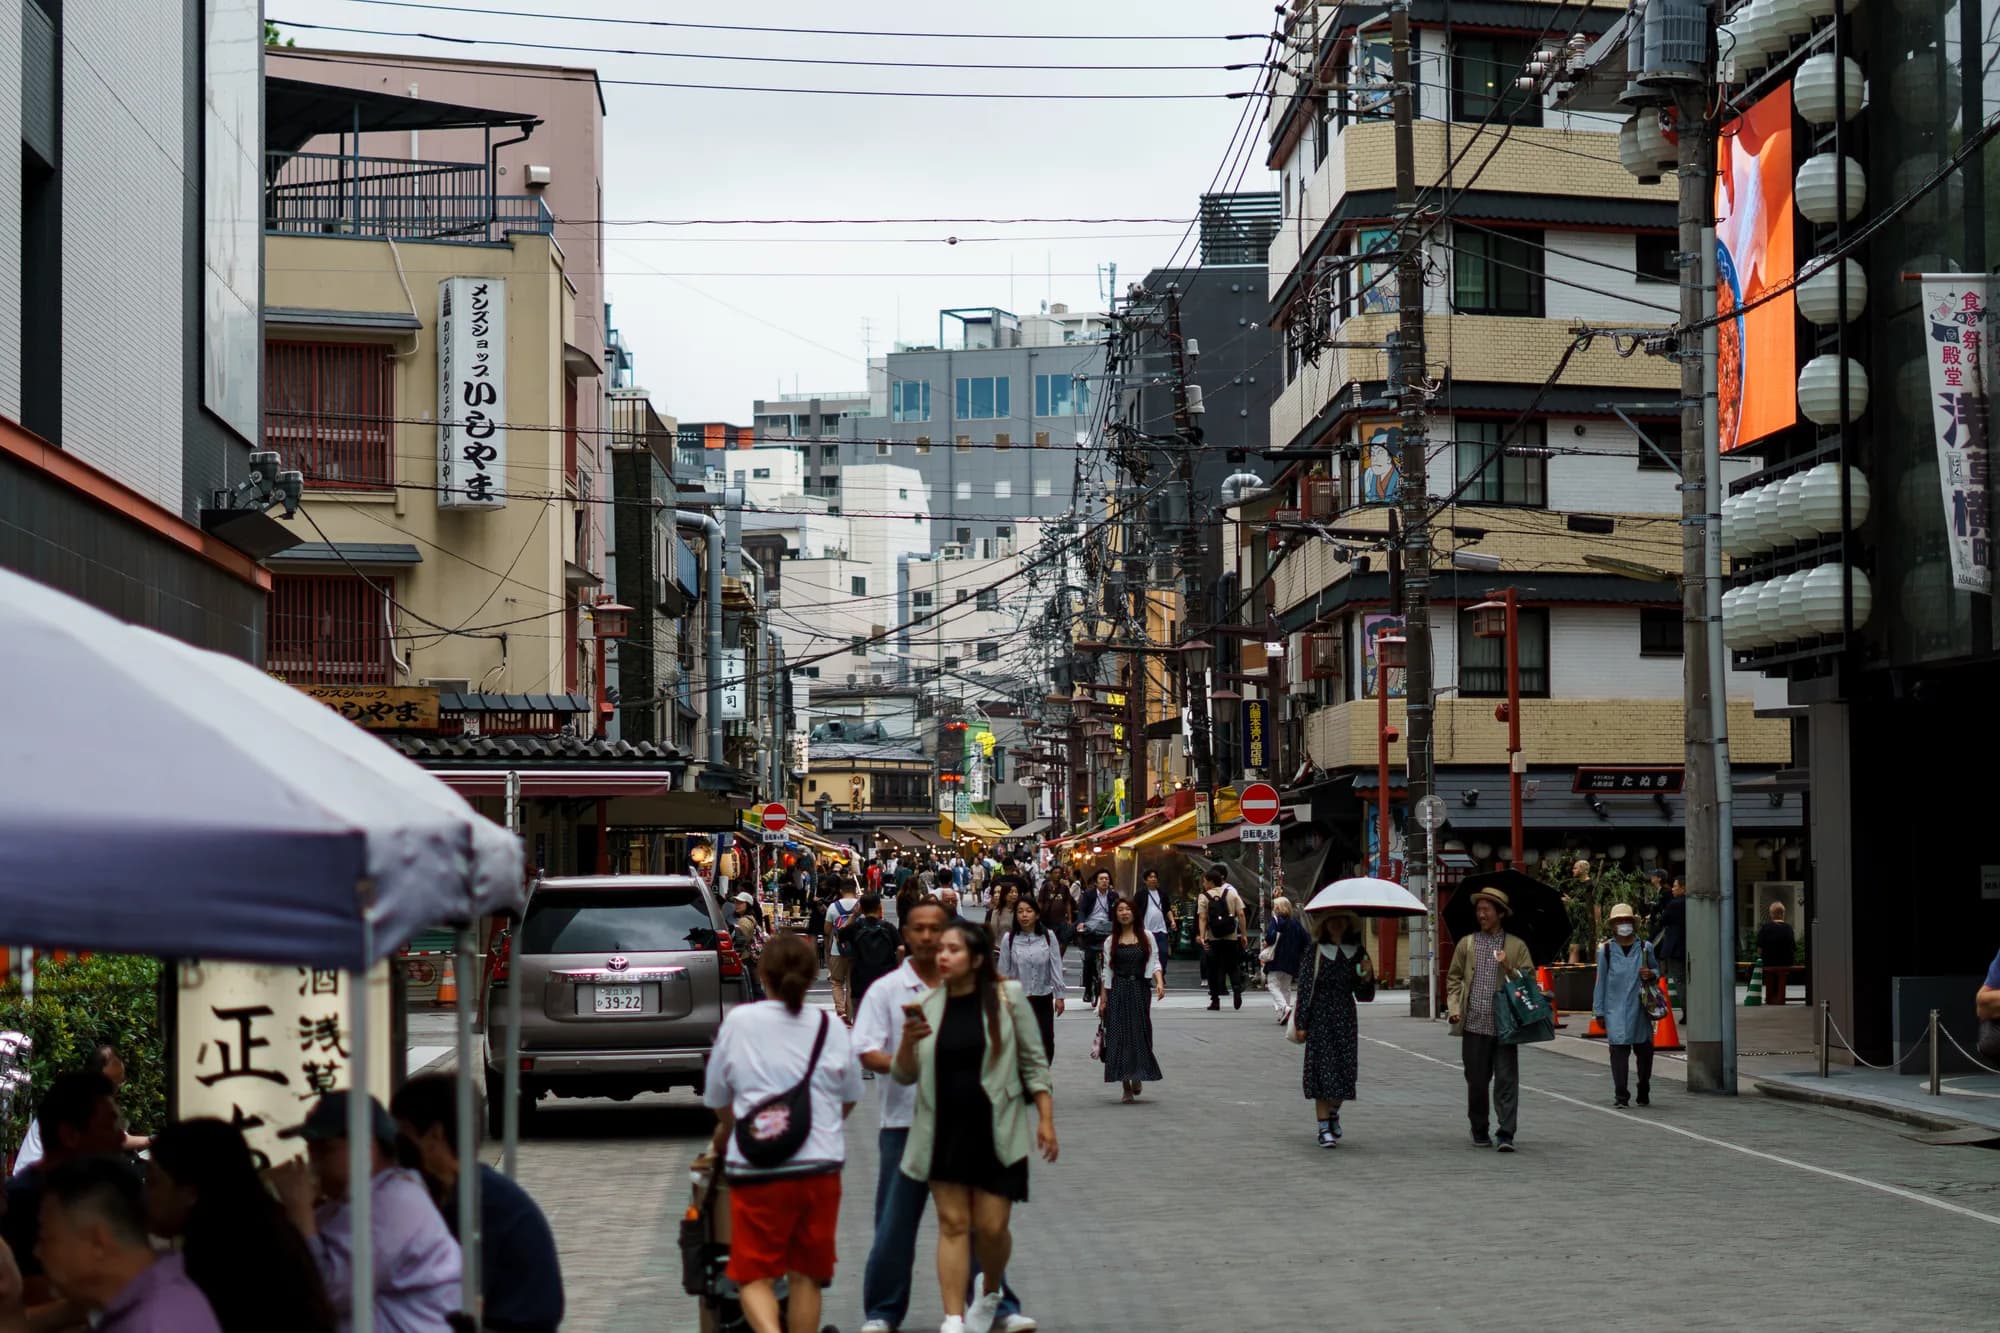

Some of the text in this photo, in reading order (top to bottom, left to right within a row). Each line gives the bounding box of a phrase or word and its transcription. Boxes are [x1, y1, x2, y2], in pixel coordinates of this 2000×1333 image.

[1961, 291, 1982, 365] 食と祭の
[1942, 345, 1964, 387] 殿堂
[463, 284, 497, 502] メンズショップ いしやま
[324, 701, 418, 722] しやま
[605, 996, 640, 1009] 39-22
